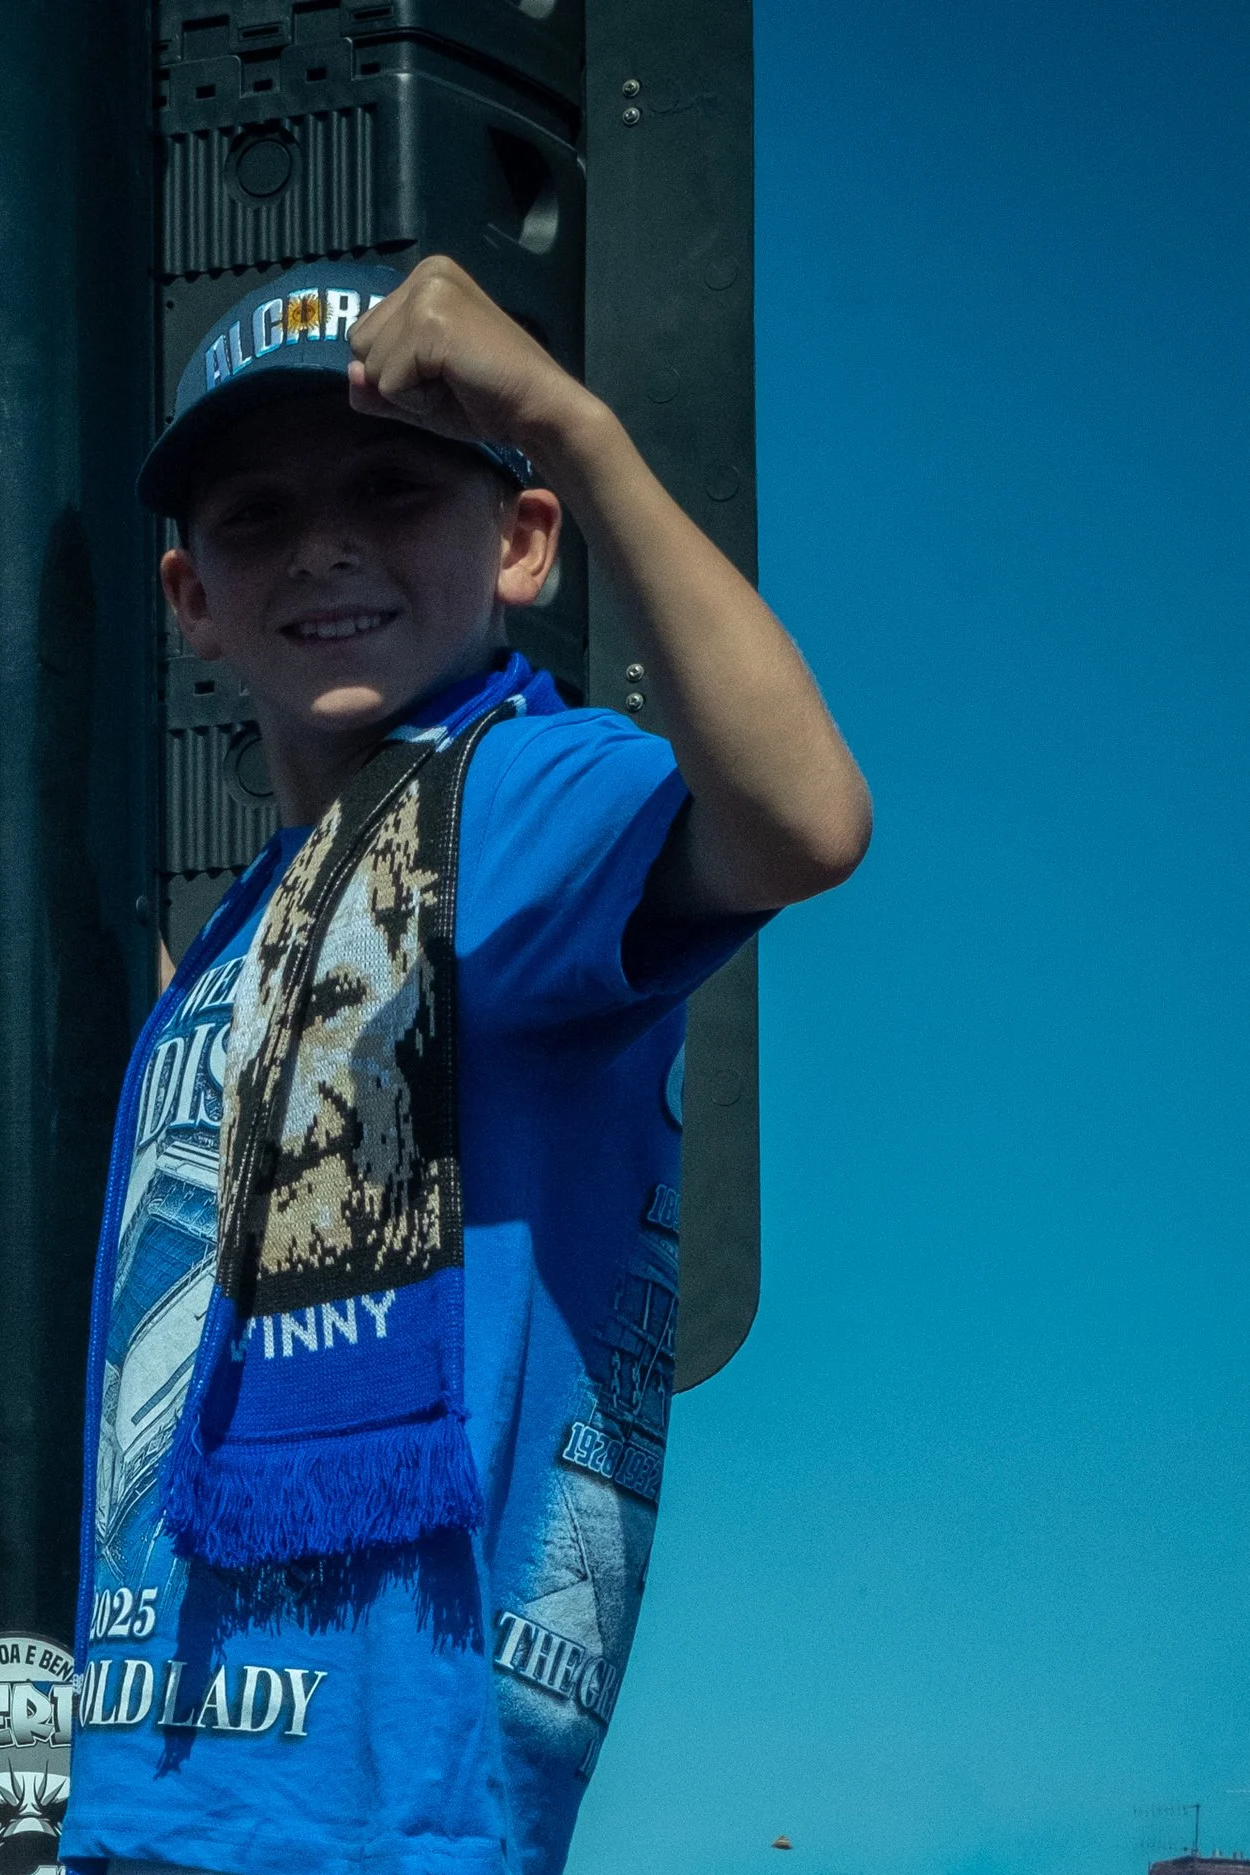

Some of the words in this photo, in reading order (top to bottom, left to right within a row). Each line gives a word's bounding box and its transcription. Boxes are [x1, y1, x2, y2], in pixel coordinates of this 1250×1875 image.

[205, 287, 387, 391] ALCAR
[562, 1421, 623, 1478] 1928
[25, 1645, 37, 1665] E
[39, 1649, 74, 1682] BEN
[494, 1611, 586, 1699] THE
[79, 1659, 154, 1727] OLD
[157, 1659, 328, 1736] LADY
